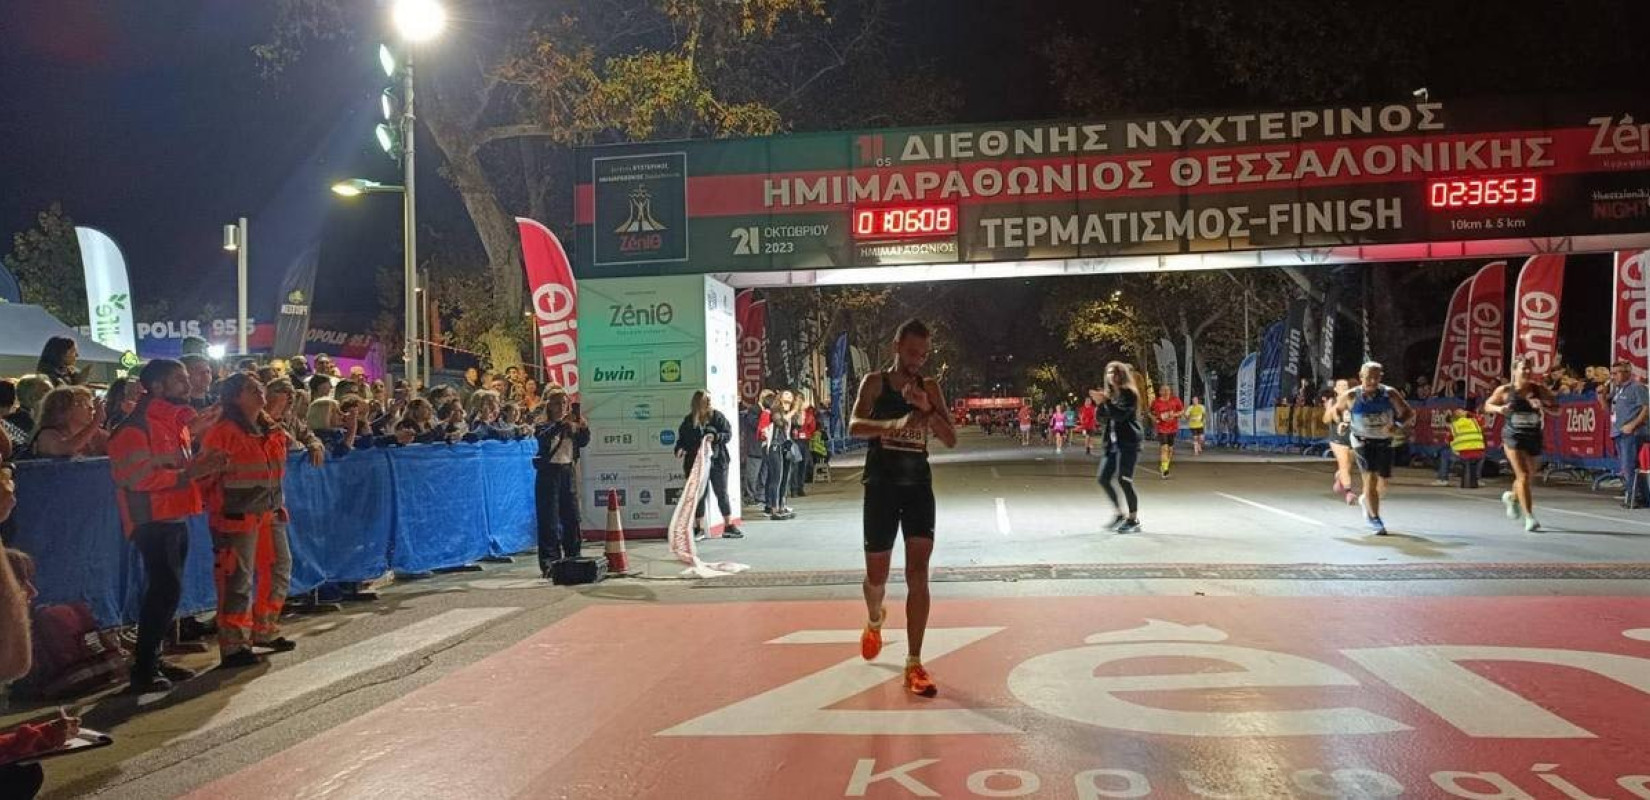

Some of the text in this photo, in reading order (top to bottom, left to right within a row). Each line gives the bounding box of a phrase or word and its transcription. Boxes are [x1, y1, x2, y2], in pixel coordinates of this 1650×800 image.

[901, 123, 1108, 161] ΔΙΕΘΝΗΣ
[1126, 102, 1445, 148] ΝΥΧΤΕΡΙΝΟΣ
[763, 137, 1554, 208] ΗΜΙΜΑΡΑΘΩΝΙΟΣ ΘΕΣΣΑΛΟΝΙΚΗΣ
[1431, 178, 1537, 207] 02:36:53
[1450, 217, 1526, 231] 10km & 5 km
[730, 224, 829, 255] 21 ΟΚΤΩΒΡΙΟΥ
[765, 242, 795, 254] 2023
[1285, 327, 1301, 376] bwin
[593, 365, 635, 382] bwin
